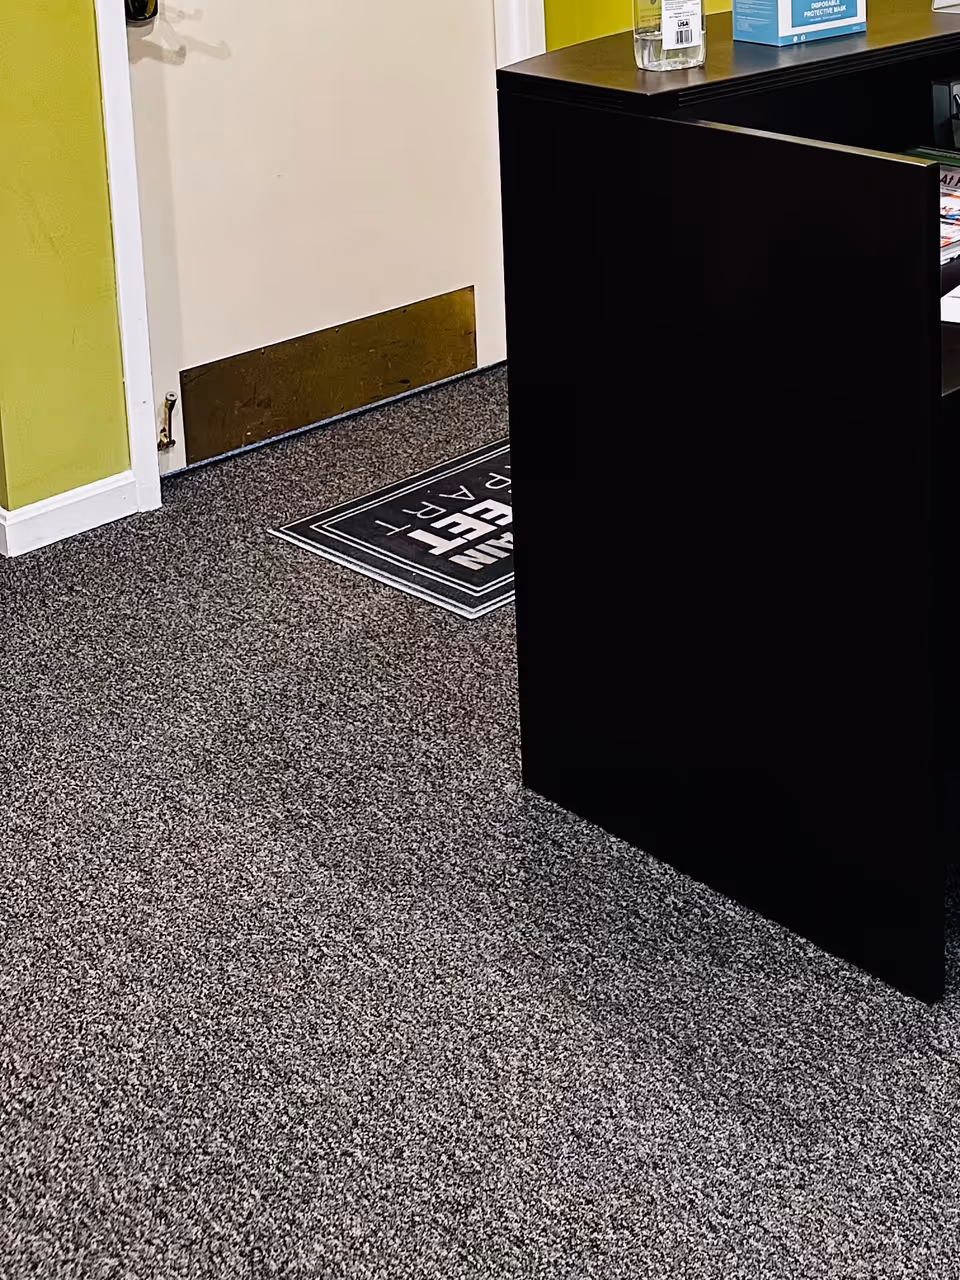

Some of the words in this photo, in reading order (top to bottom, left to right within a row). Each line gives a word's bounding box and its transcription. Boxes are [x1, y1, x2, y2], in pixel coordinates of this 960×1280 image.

[811, 0, 840, 9] DISPOSABLE
[804, 8, 833, 17] PROTECTIVE
[940, 174, 954, 185] At
